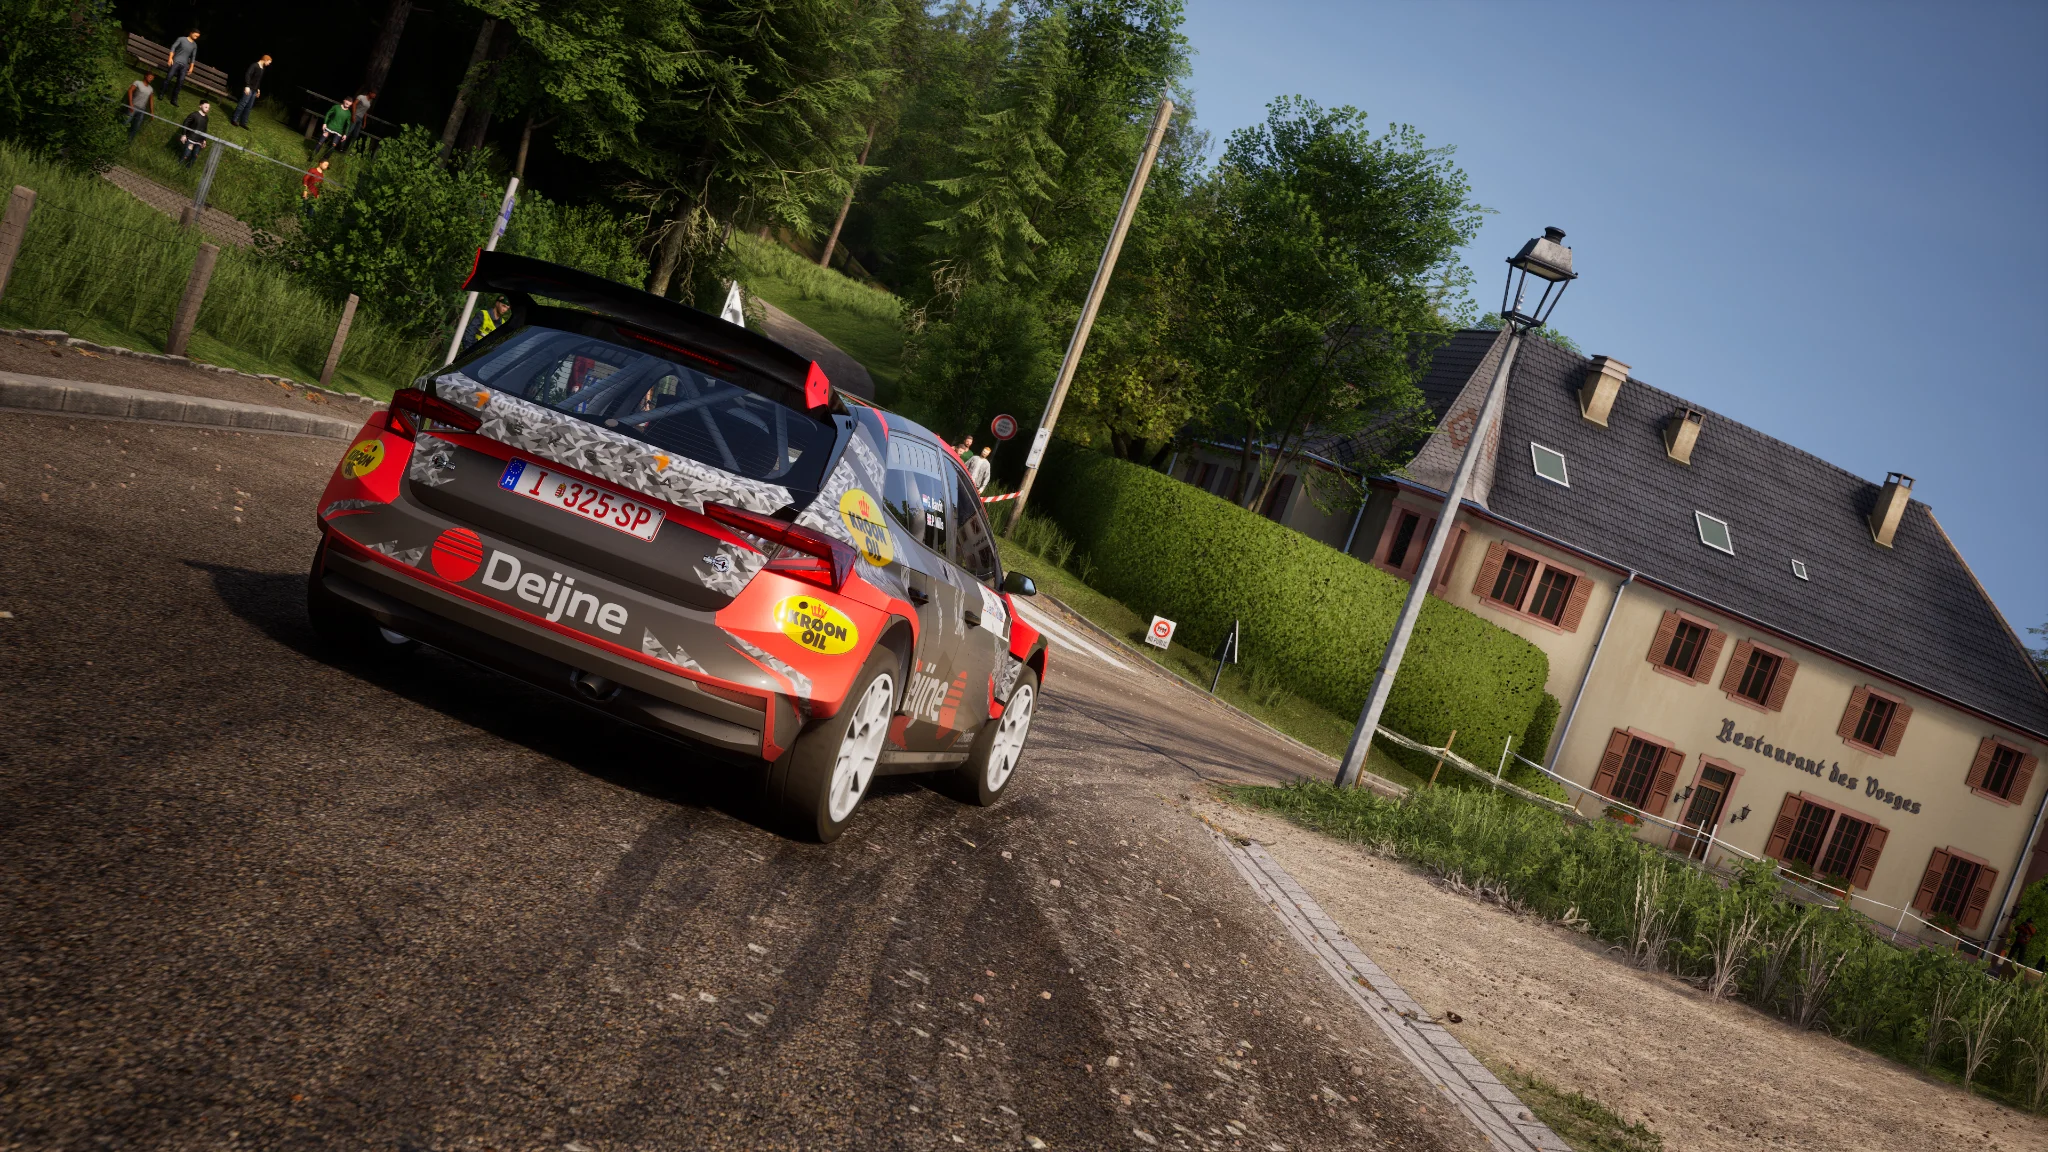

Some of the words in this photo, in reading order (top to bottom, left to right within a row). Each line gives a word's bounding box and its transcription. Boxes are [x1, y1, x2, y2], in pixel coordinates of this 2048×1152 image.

[504, 475, 516, 487] H
[563, 483, 652, 531] 325-SP
[848, 511, 888, 545] KROON
[865, 537, 883, 562] OIL
[481, 549, 629, 634] Deijne
[787, 609, 848, 642] KROON
[801, 629, 827, 651] OIL
[1715, 717, 1826, 778] Restaurant
[1828, 761, 1860, 791] des
[1865, 775, 1923, 815] Vosges
